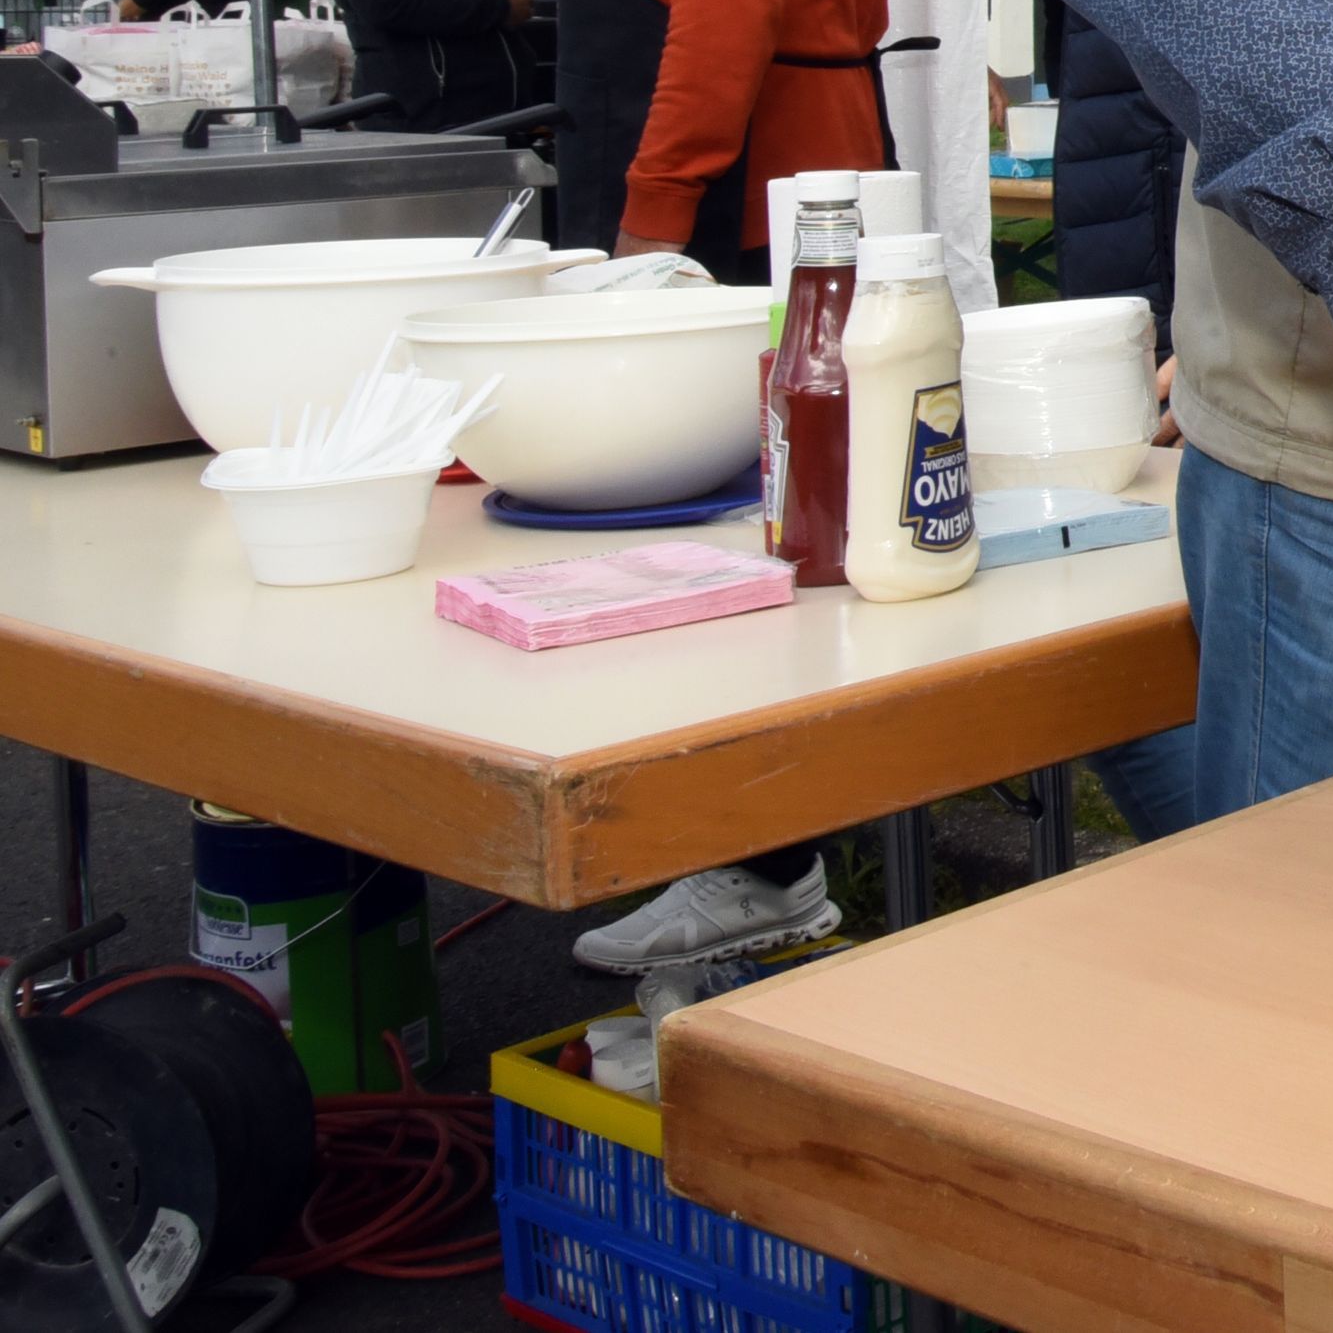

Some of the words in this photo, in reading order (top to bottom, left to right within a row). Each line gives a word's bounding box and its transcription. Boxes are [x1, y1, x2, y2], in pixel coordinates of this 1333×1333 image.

[920, 454, 957, 473] ORIGINAL
[914, 466, 970, 507] MAYO
[924, 506, 971, 541] HEINZ
